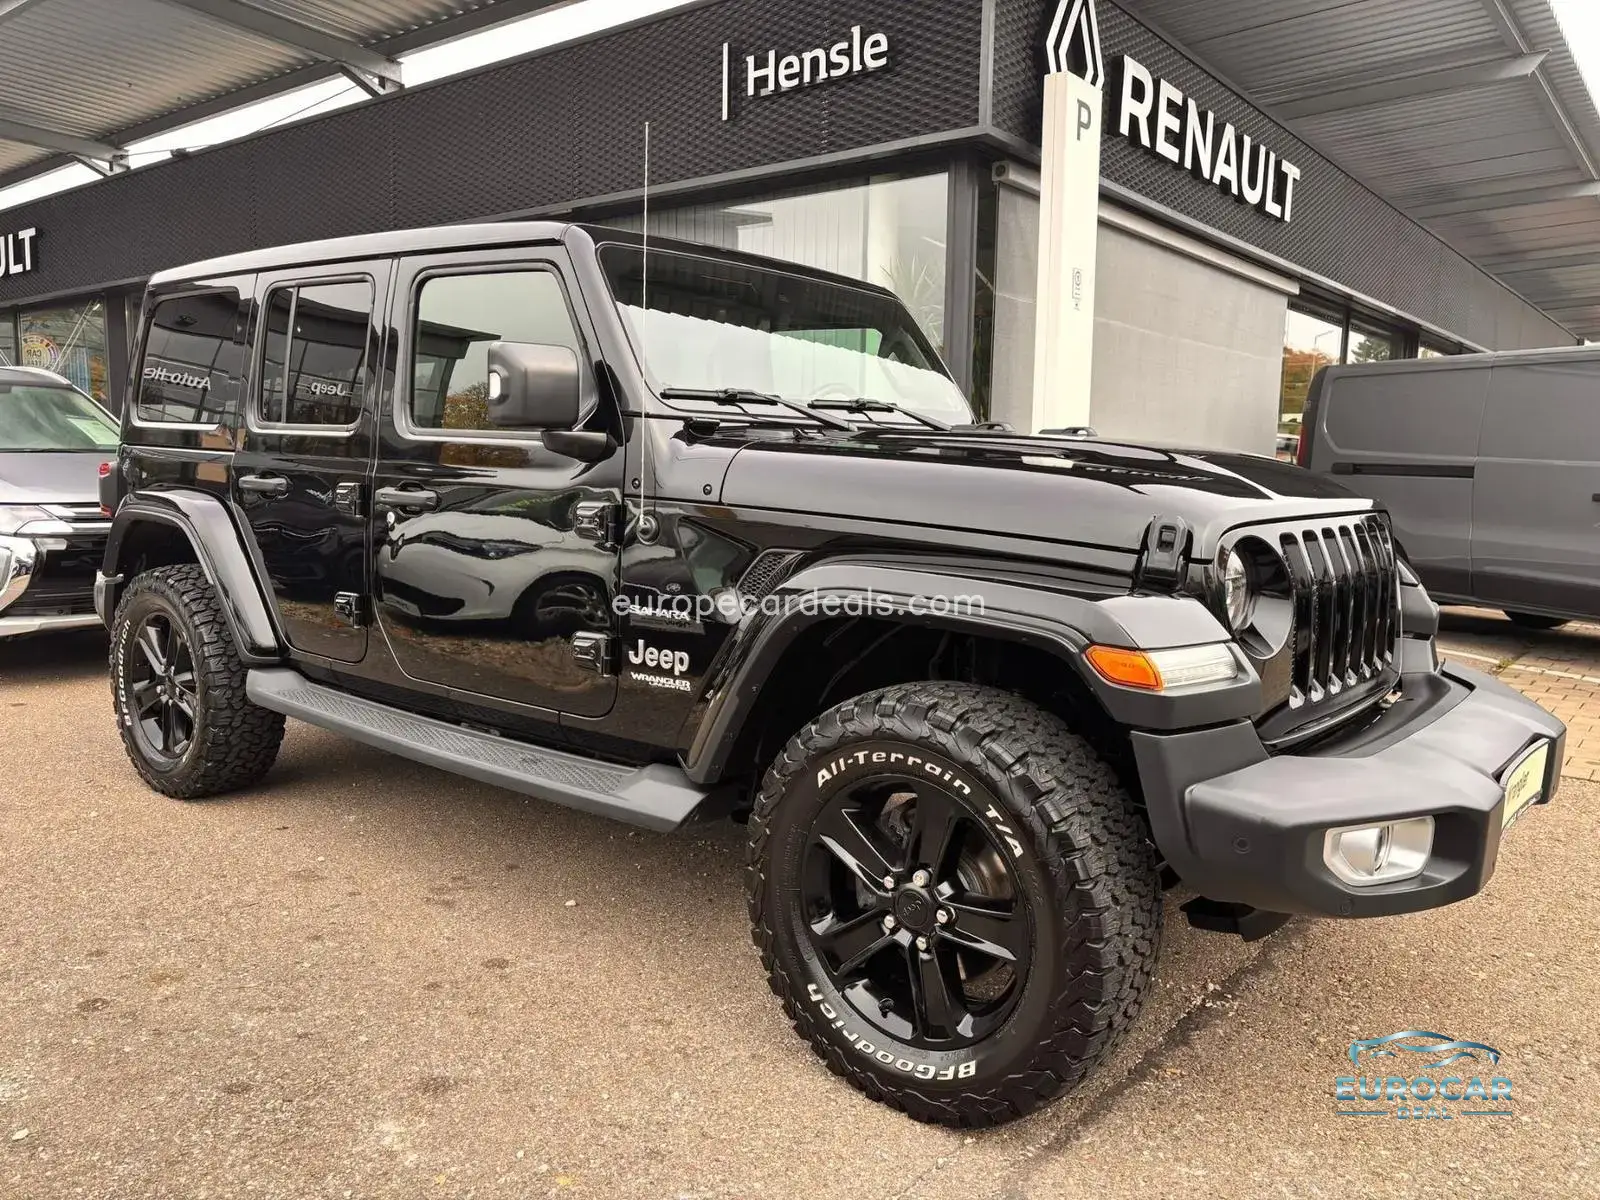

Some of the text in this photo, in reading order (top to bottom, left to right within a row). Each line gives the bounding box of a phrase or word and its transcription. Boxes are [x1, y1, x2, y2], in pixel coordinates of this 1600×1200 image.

[746, 25, 889, 97] Hensle
[1076, 98, 1092, 142] P
[1119, 54, 1301, 223] RENAULT
[629, 604, 691, 621] SAHARA
[118, 619, 132, 727] BFGoodrich
[628, 639, 690, 676] Jeep
[630, 671, 691, 688] WRANGLER
[649, 680, 692, 692] UNLIMITED
[816, 750, 1024, 858] All-Terrain T/A
[807, 983, 977, 1081] BFGoodrich
